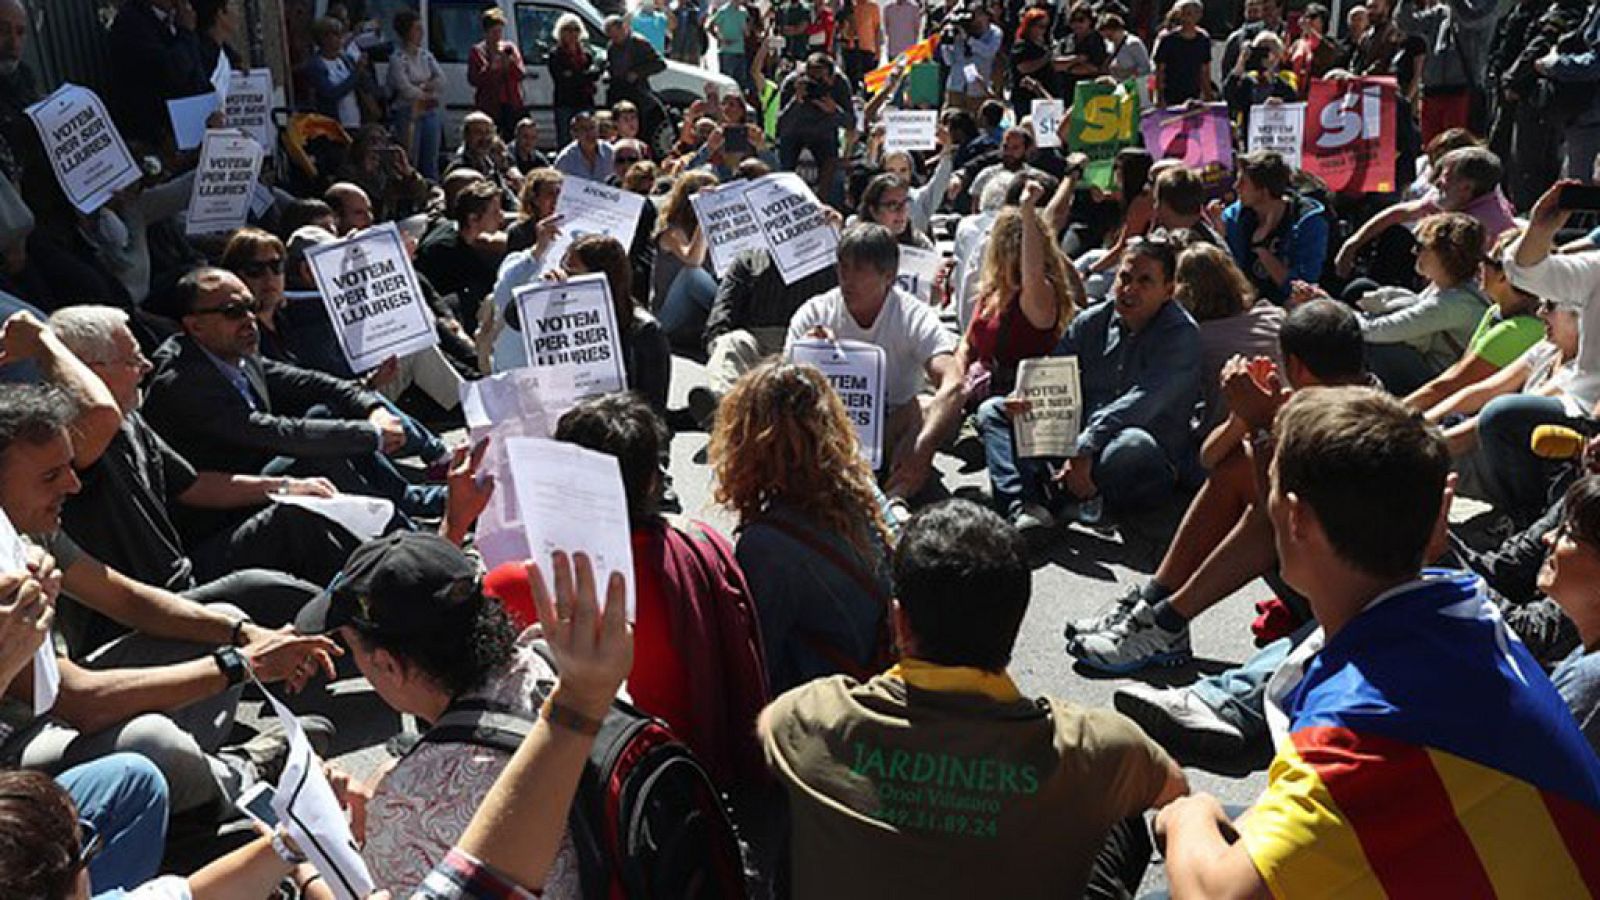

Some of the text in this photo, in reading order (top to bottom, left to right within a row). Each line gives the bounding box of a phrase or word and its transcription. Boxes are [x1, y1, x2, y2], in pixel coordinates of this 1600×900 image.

[52, 105, 95, 142] VOTEM
[55, 117, 106, 160] PER SER
[61, 132, 112, 174] LLIURES
[210, 157, 253, 169] VOTEM
[201, 169, 252, 182] PER SER
[199, 183, 247, 197] LLIURES
[707, 203, 748, 221] VOTEM
[764, 213, 792, 232] PER
[332, 259, 396, 291] VOTEM
[333, 274, 407, 310] PER SER
[341, 290, 412, 326] LLIURES
[536, 310, 601, 333] VOTEM
[535, 327, 609, 353] PER SER
[828, 374, 868, 390] TEM
[1023, 384, 1068, 398] VOTEM
[852, 741, 1039, 794] JARDINERS
